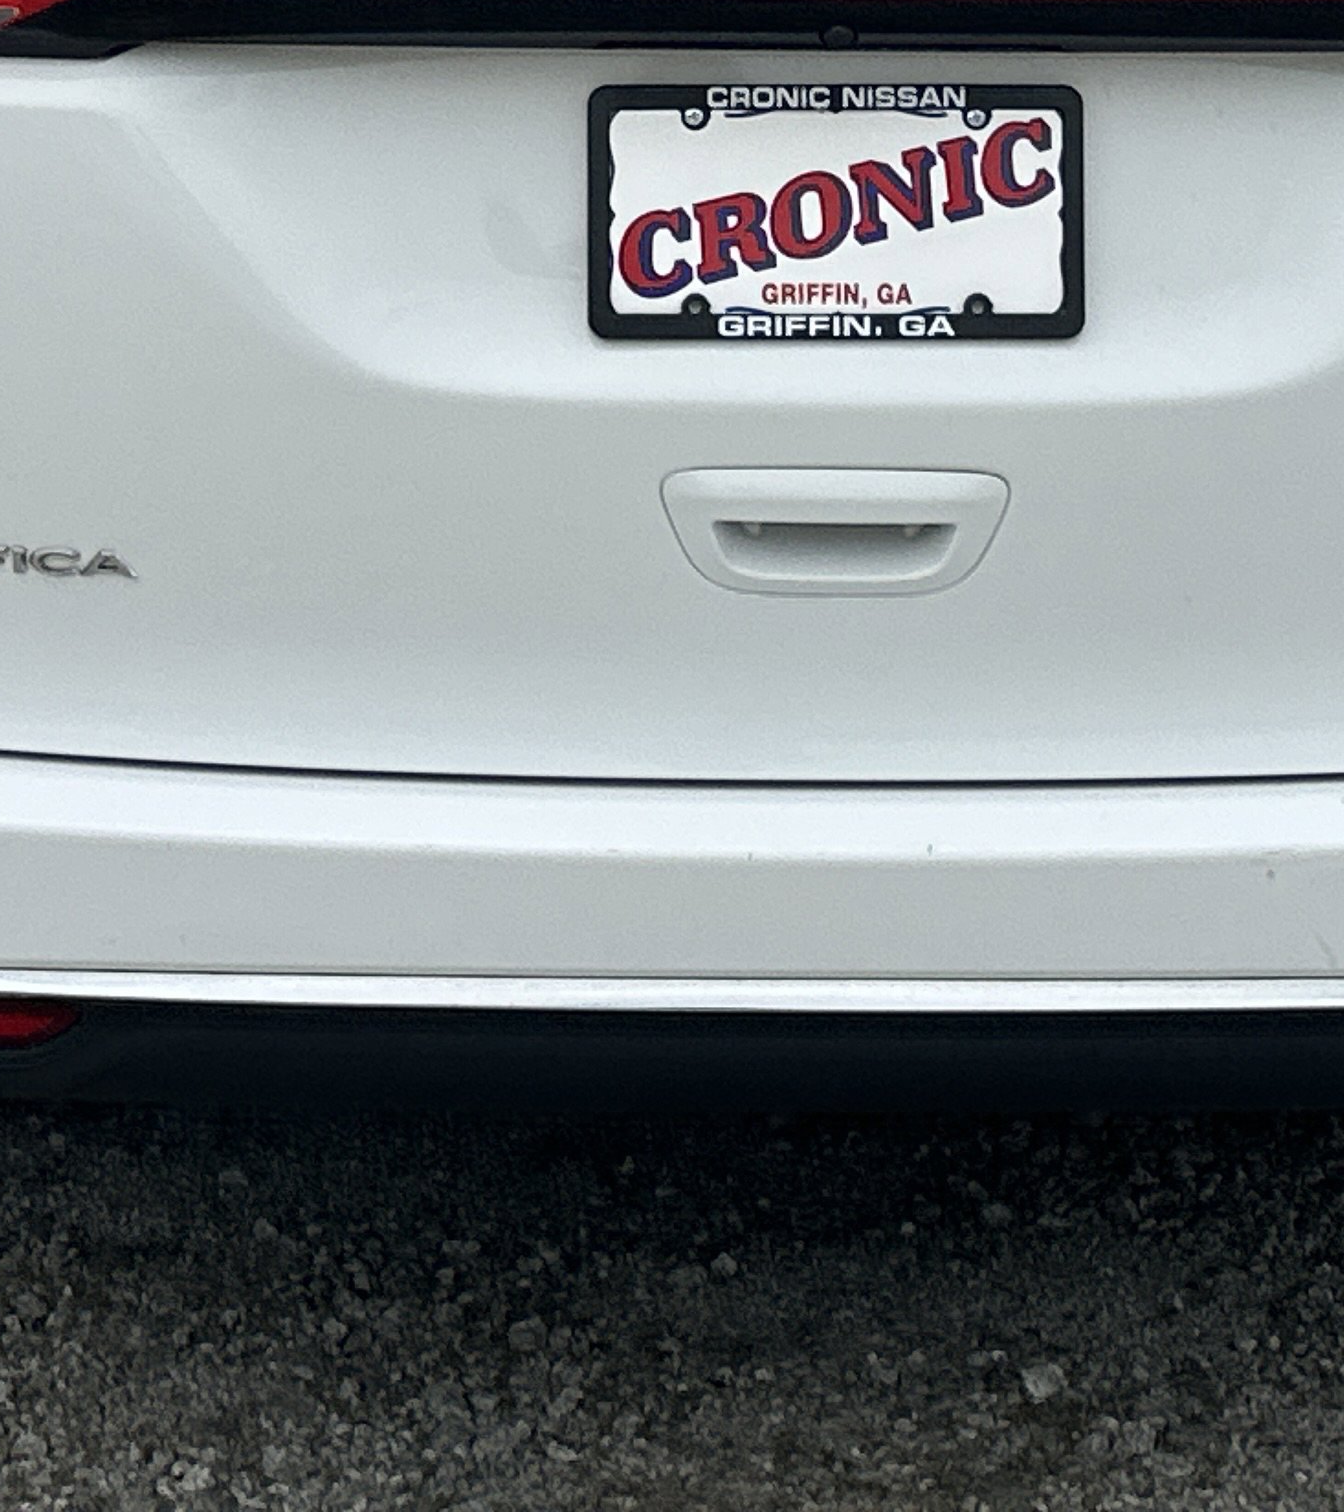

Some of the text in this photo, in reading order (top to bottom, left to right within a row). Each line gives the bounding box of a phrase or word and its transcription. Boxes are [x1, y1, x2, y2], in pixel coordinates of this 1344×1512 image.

[707, 87, 966, 109] CRONIC NISSAN
[618, 118, 1055, 298] CRONIC
[761, 283, 912, 308] GRIFFIN, GA
[718, 315, 955, 337] GRIFFIN, GA
